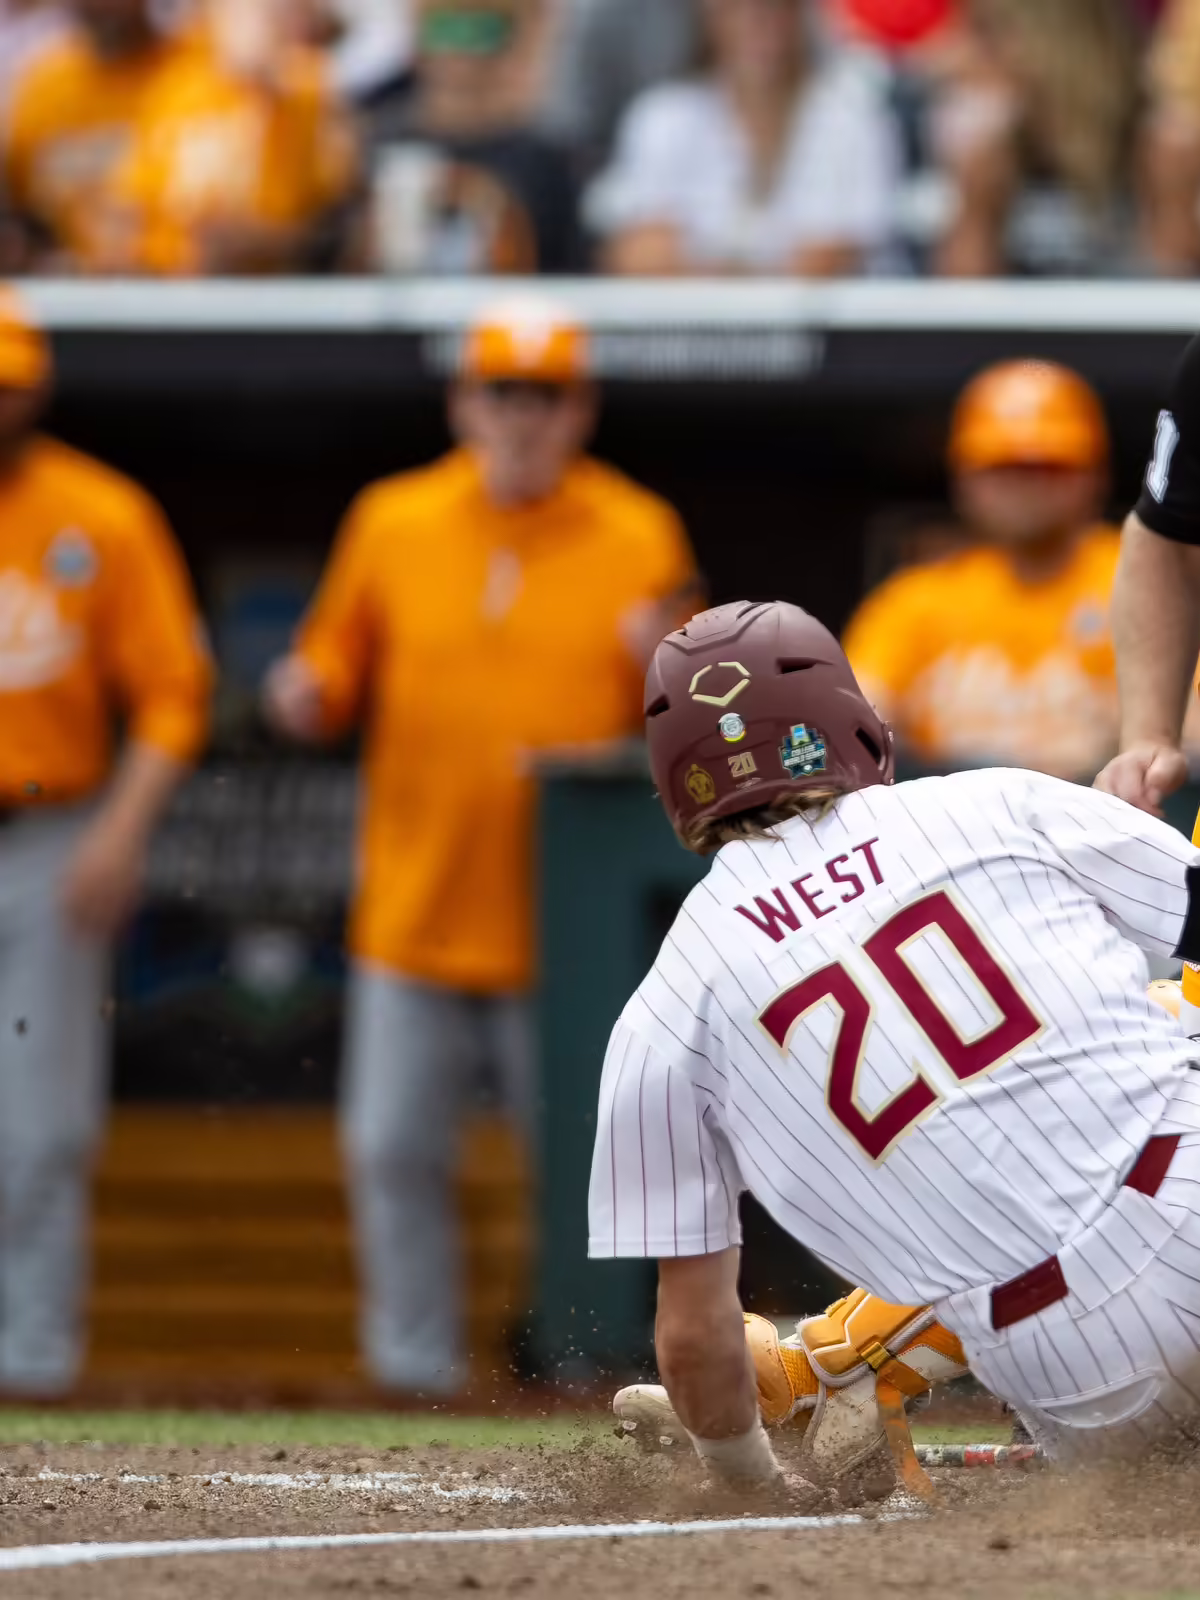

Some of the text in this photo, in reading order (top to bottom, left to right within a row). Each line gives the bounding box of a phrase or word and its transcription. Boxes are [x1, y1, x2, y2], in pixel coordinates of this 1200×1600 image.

[727, 751, 758, 777] 20
[733, 836, 884, 943] WEST
[752, 882, 1048, 1170] 20
